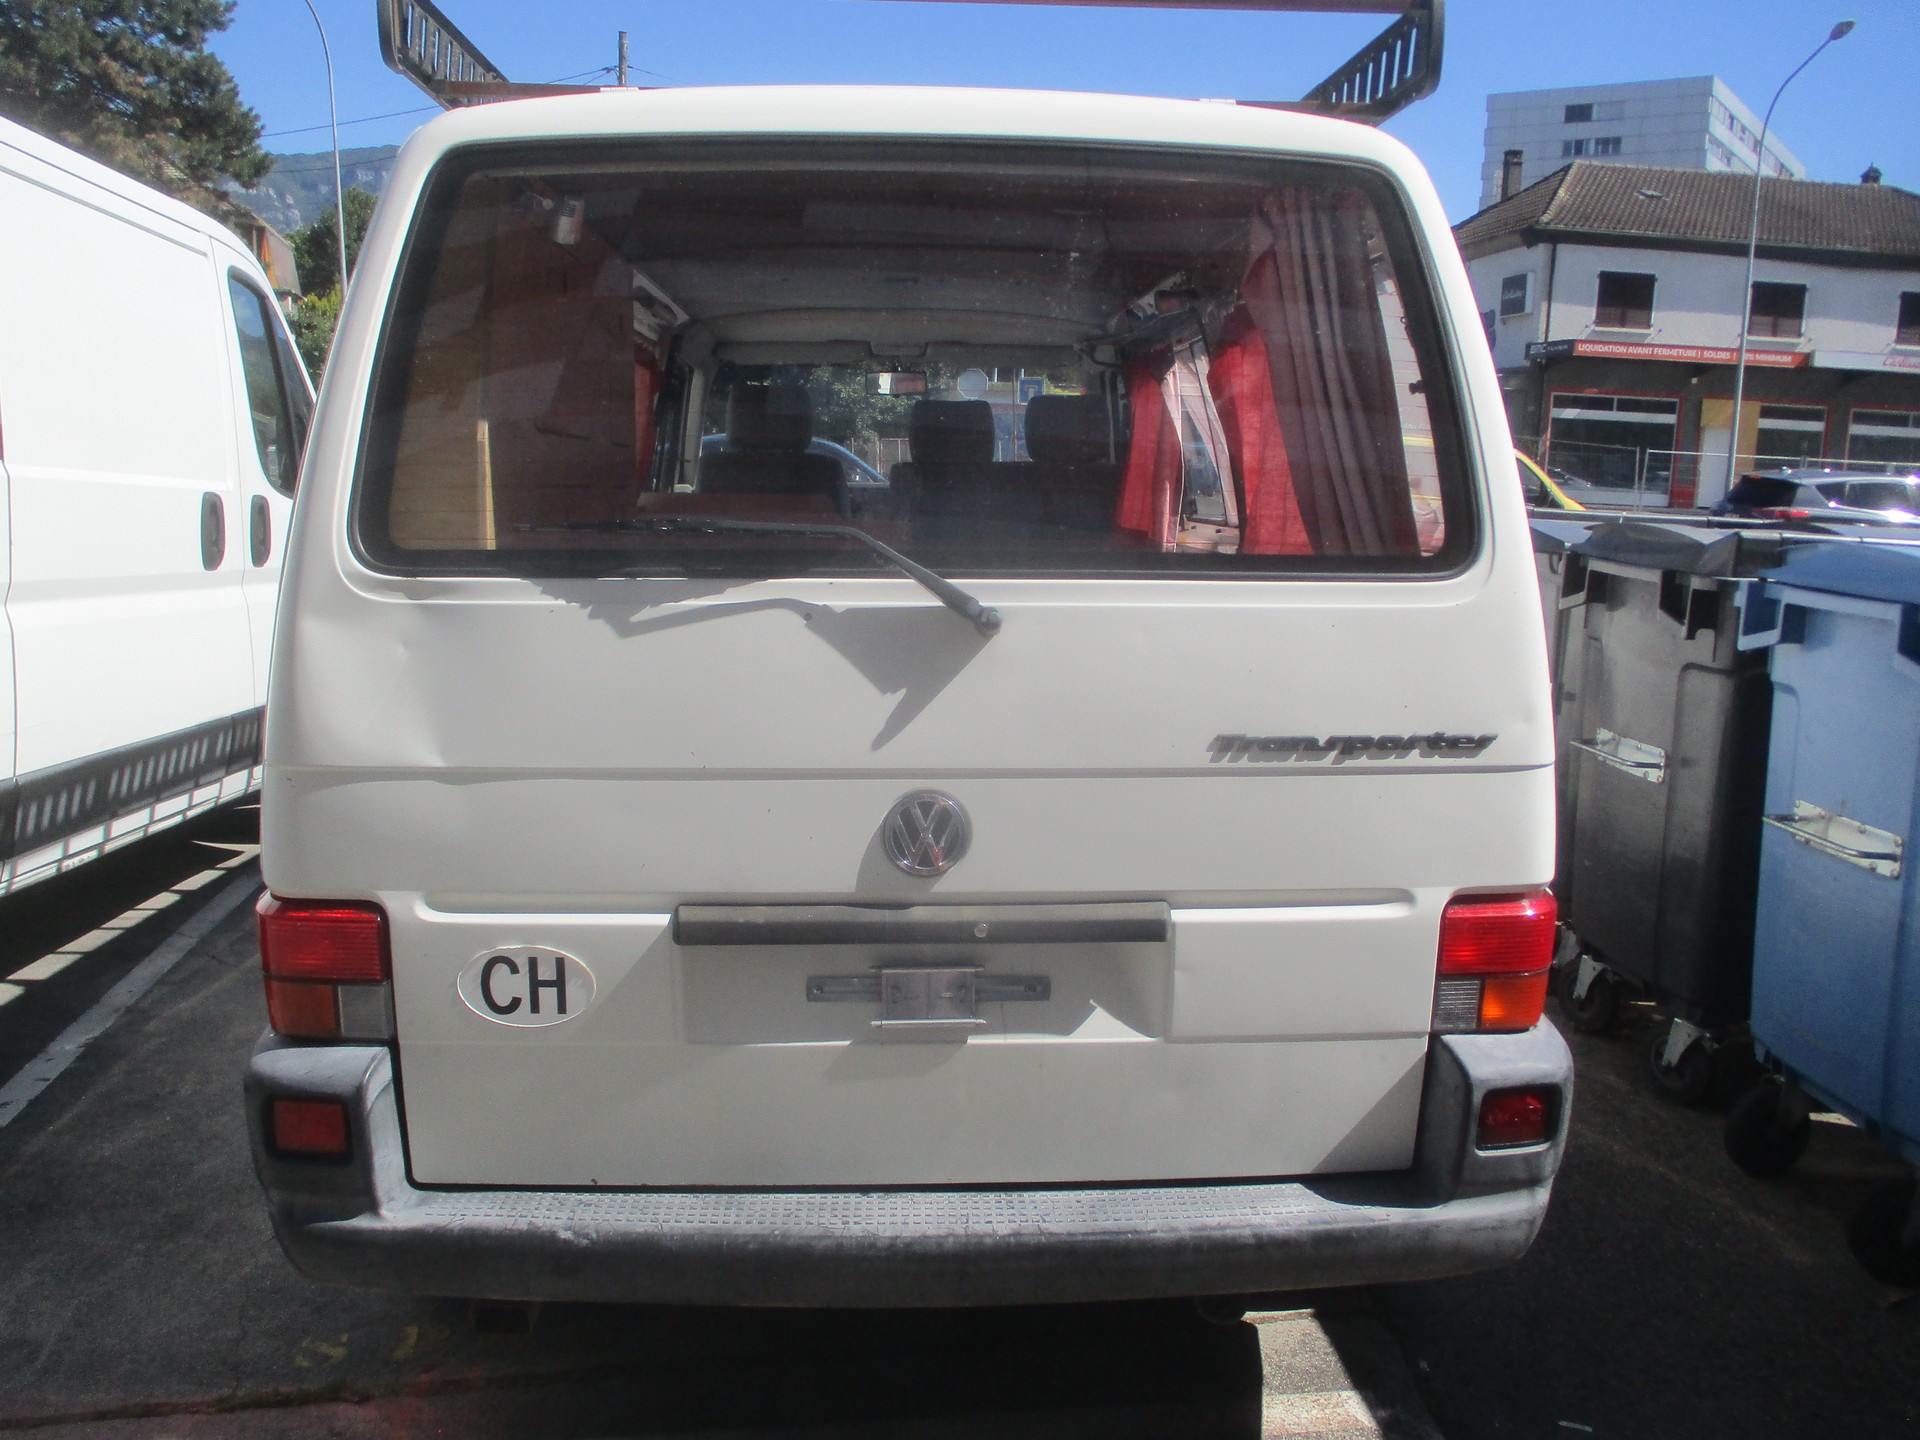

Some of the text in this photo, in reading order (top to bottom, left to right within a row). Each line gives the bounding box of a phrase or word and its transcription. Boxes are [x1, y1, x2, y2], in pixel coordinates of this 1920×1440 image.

[1578, 343, 1627, 354] LIQUIDATION
[1627, 346, 1653, 355] AVANT
[1653, 347, 1697, 357] FERMETURE
[1703, 350, 1731, 359] SOLDES
[1755, 352, 1793, 362] MINIMUM
[1208, 731, 1498, 761] Transporter
[480, 955, 567, 1015] CH
